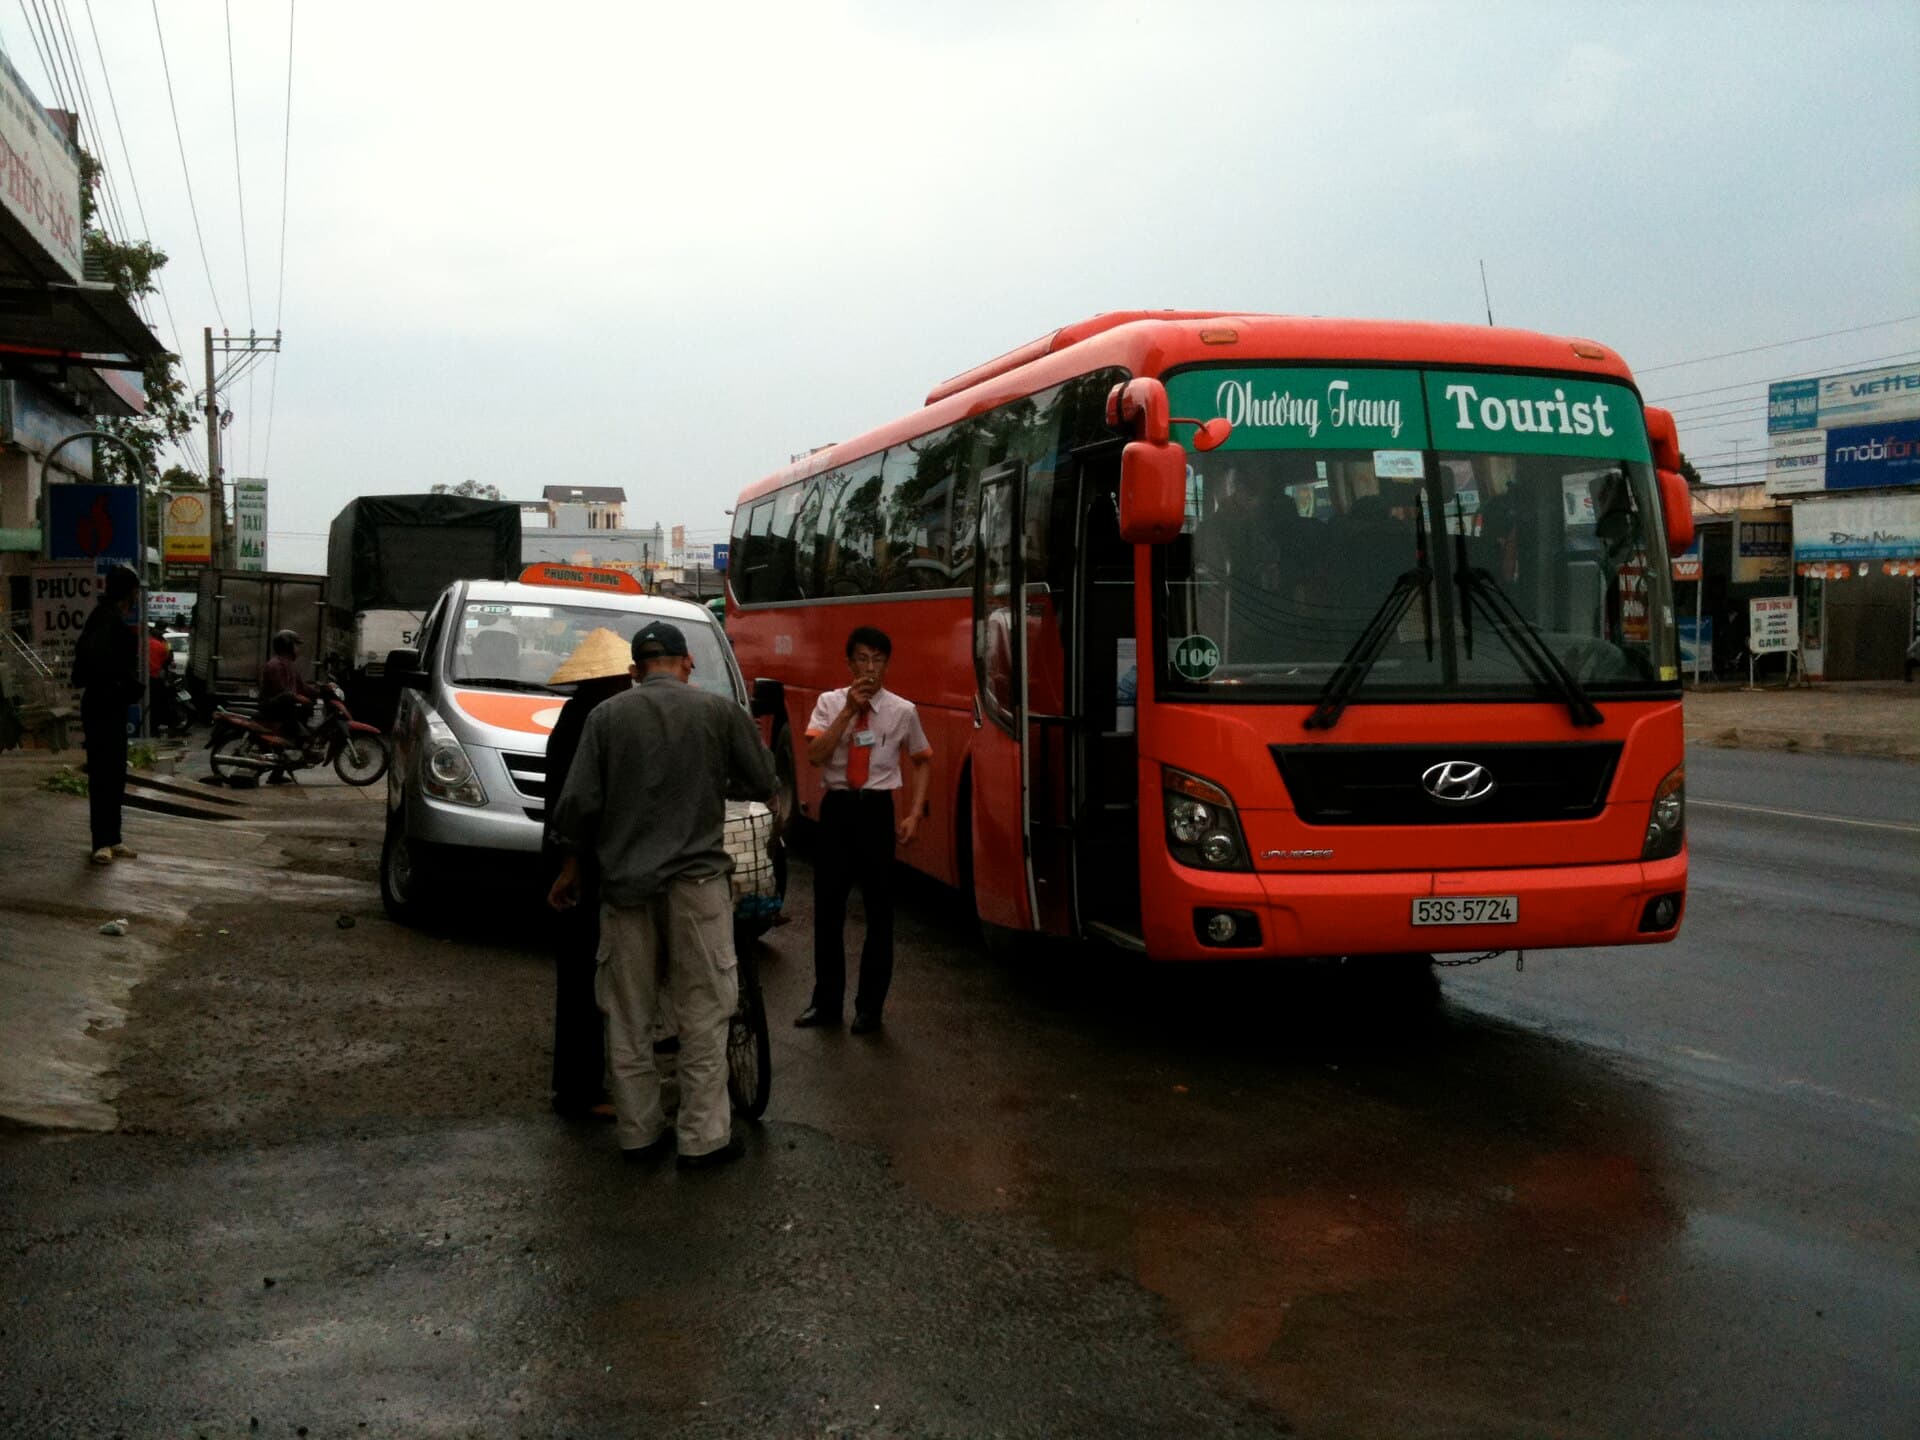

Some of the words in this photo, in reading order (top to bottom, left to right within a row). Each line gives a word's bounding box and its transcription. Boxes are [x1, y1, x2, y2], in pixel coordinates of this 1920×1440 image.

[1850, 375, 1920, 397] VIETTE
[1328, 380, 1403, 438] Trang
[1445, 384, 1614, 437] Tourist
[36, 572, 91, 599] PHÚC
[46, 604, 84, 637] LỘC
[1759, 637, 1788, 648] GAME
[1178, 648, 1217, 667] 106
